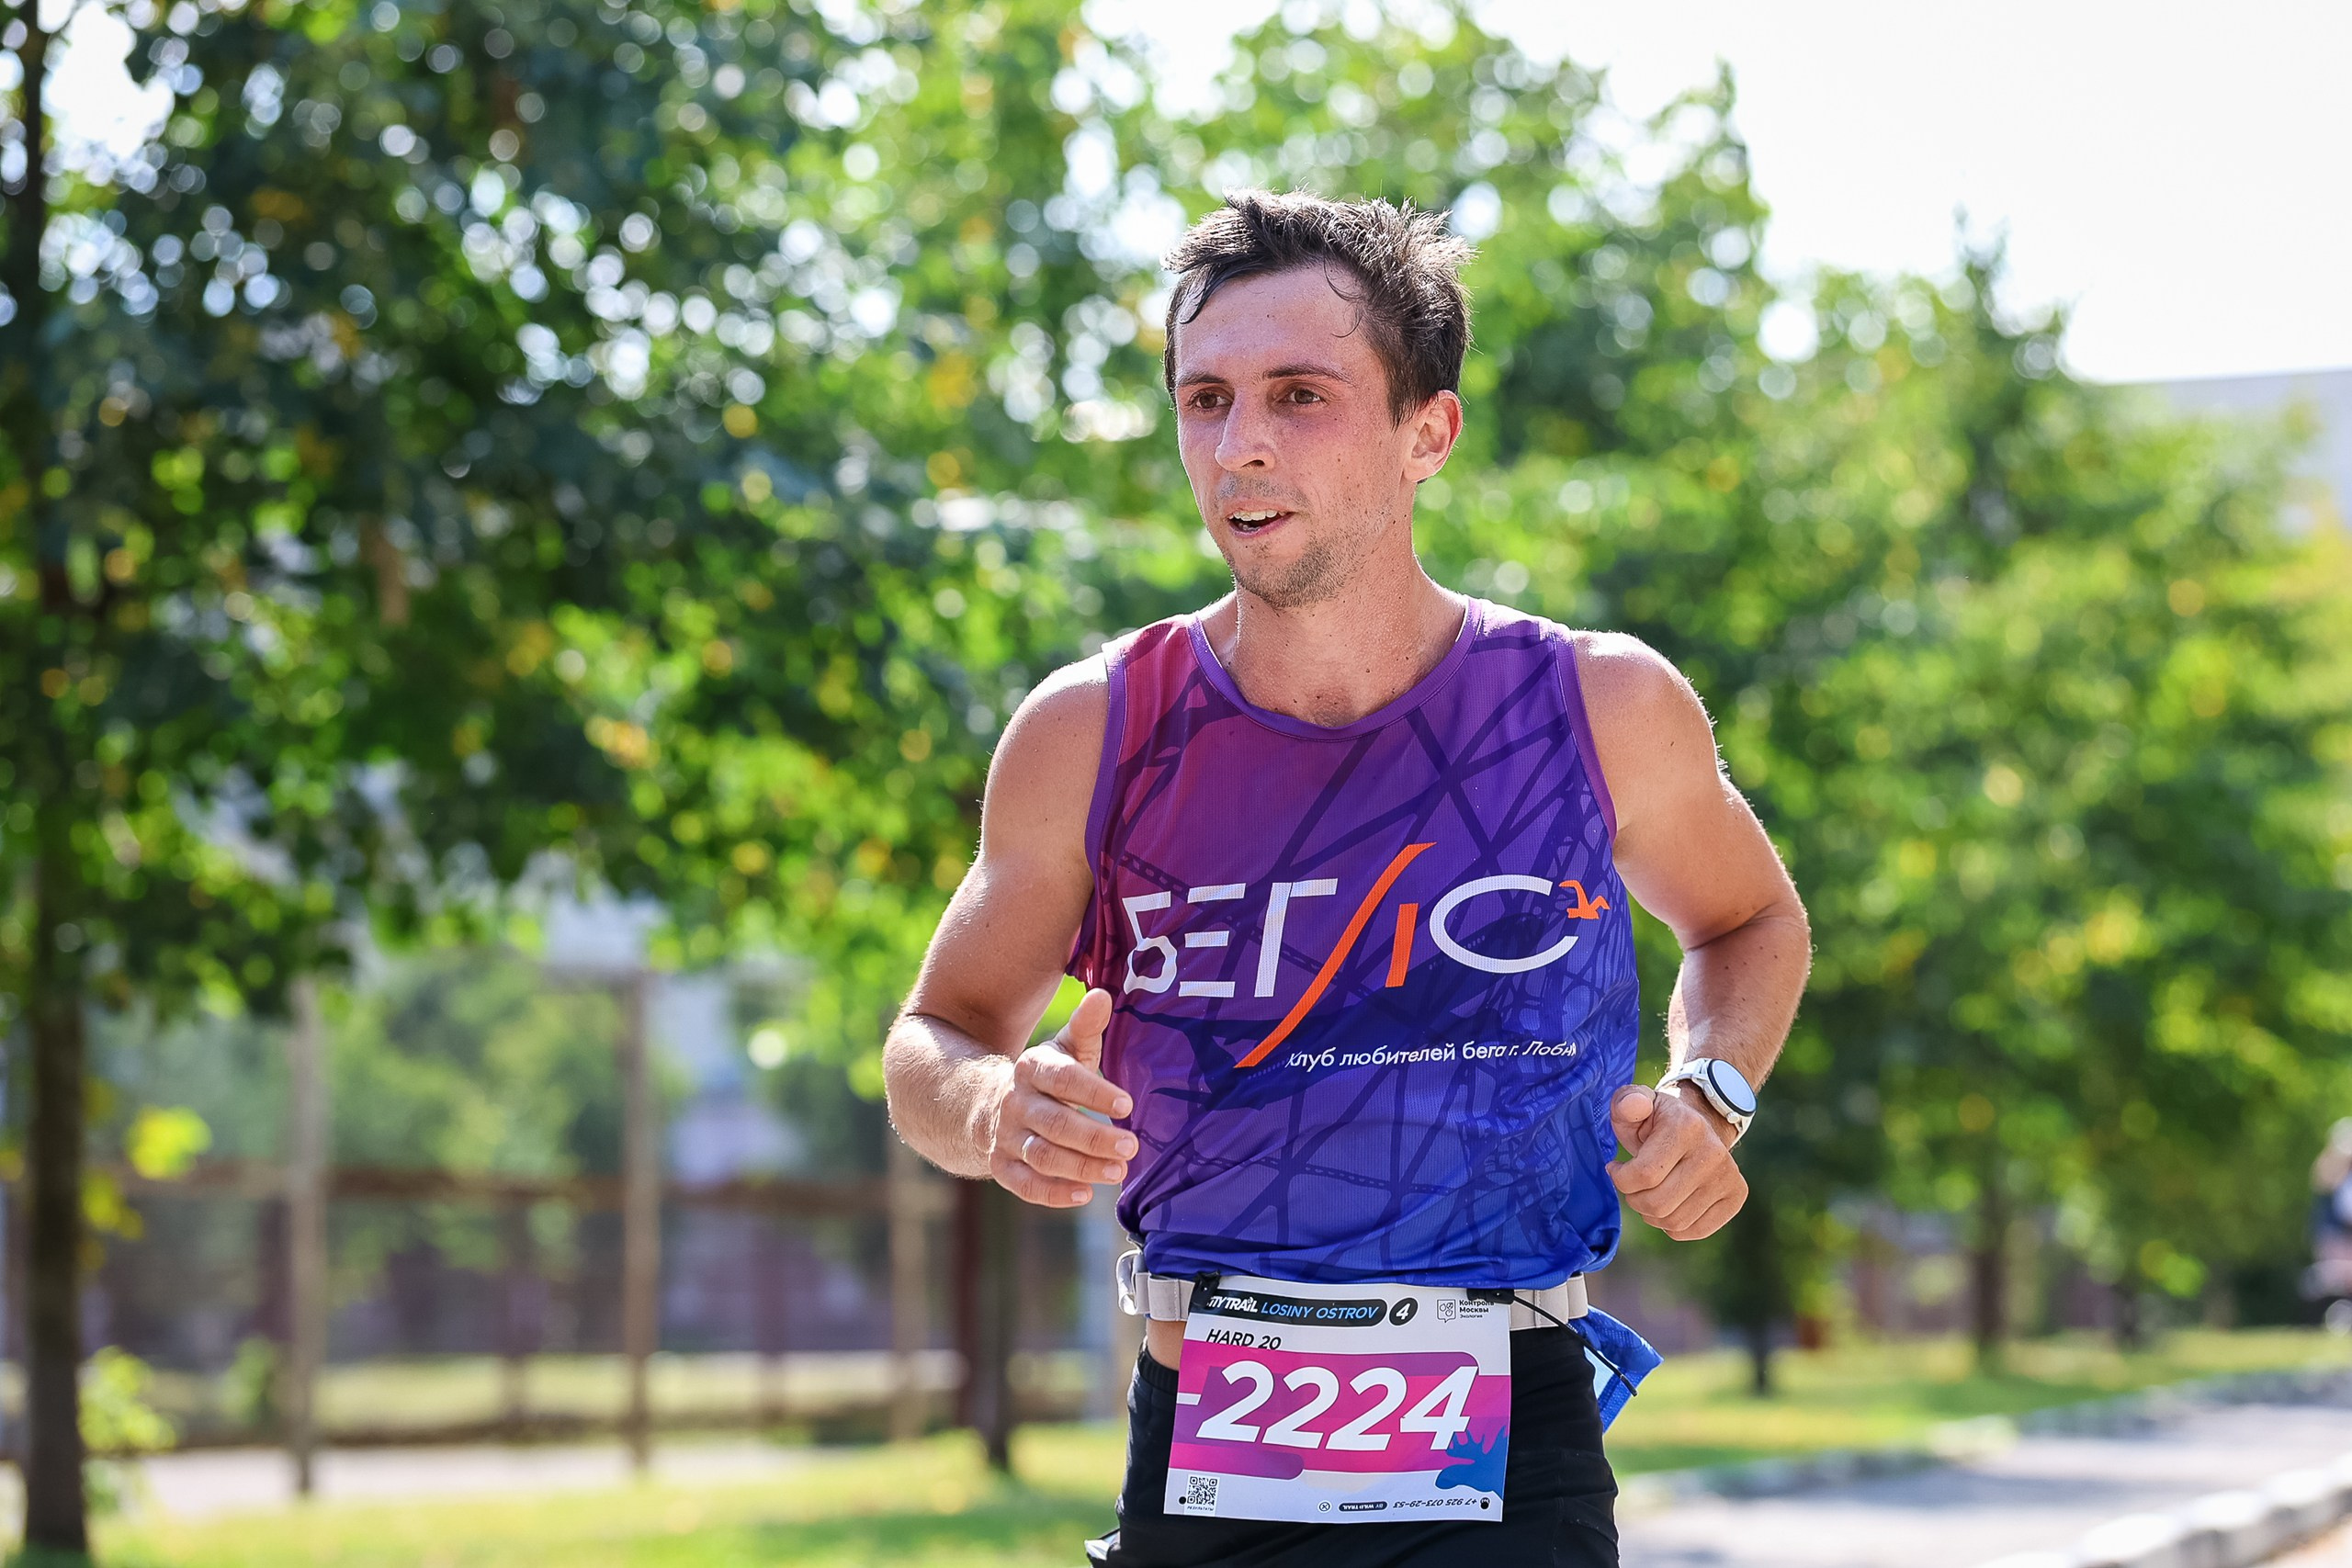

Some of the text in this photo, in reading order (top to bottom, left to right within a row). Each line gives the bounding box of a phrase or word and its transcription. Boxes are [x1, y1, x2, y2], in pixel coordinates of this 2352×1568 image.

[1339, 1043, 1455, 1066] любителей
[1463, 1040, 1508, 1059] бега
[1508, 1044, 1520, 1056] г.
[1261, 1302, 1314, 1318] LOSINY
[1316, 1306, 1380, 1320] OSTROV
[1396, 1303, 1411, 1320] 4
[1205, 1328, 1282, 1351] HARD 20
[1196, 1359, 1479, 1451] 2224
[1393, 1498, 1444, 1508] 073-29-53
[1445, 1498, 1464, 1506] 925
